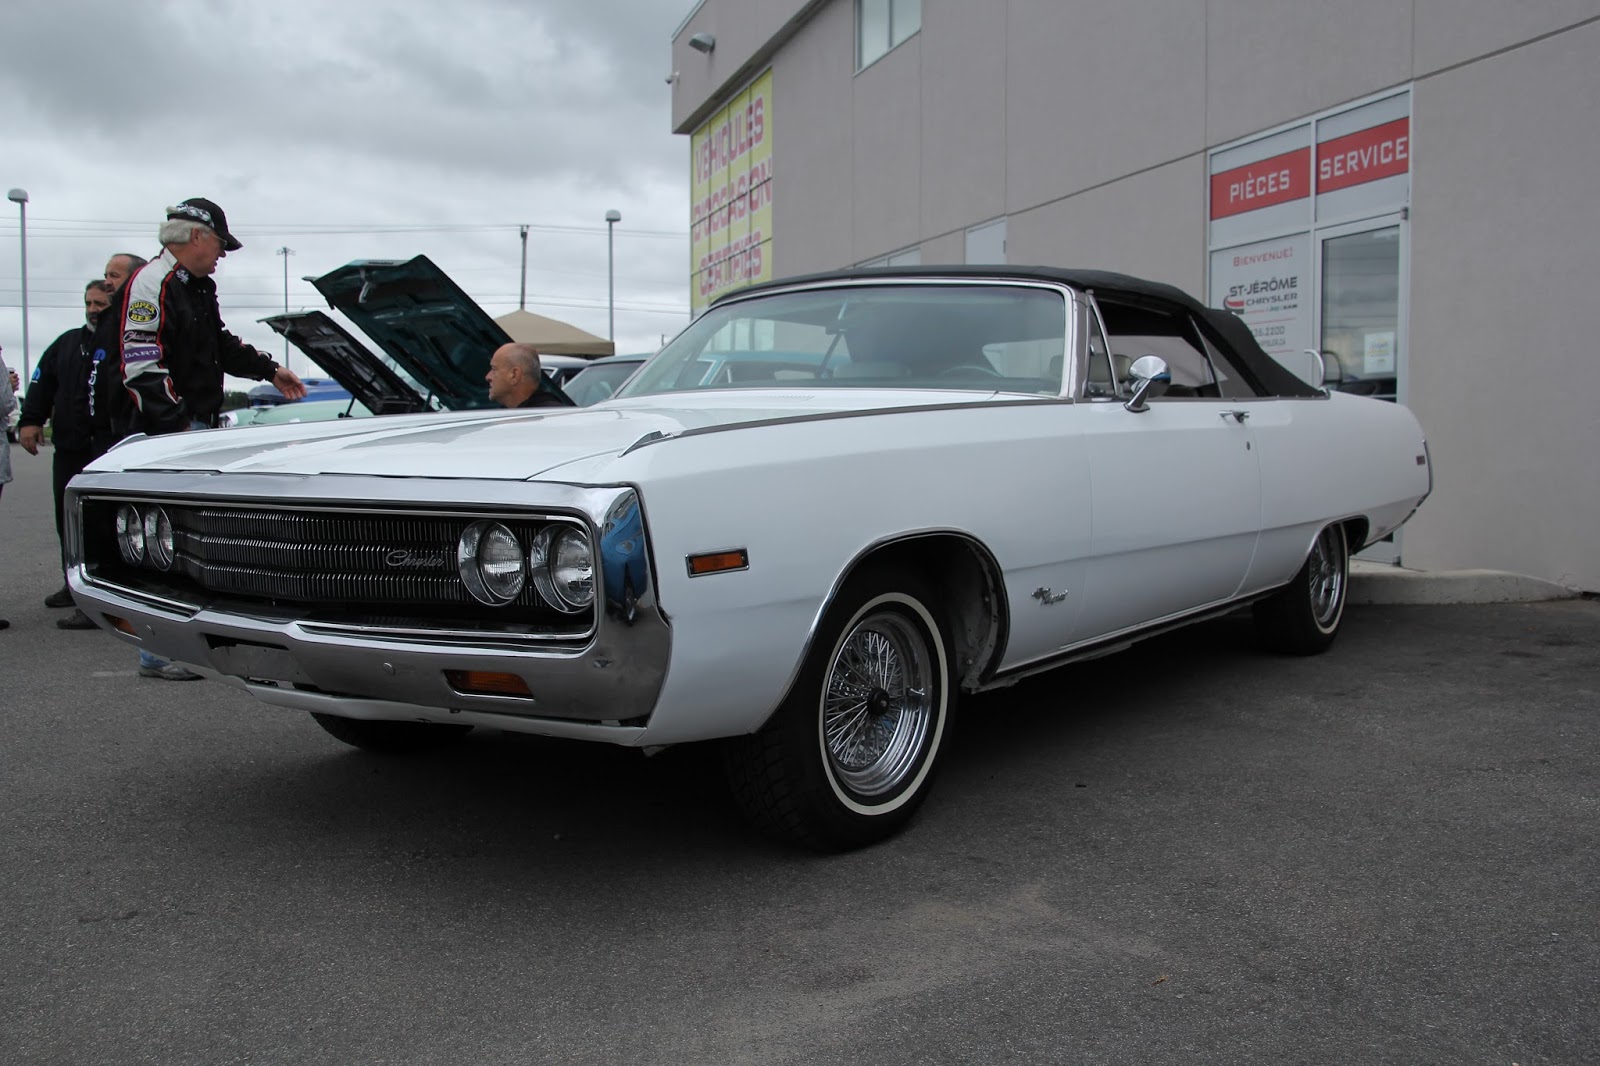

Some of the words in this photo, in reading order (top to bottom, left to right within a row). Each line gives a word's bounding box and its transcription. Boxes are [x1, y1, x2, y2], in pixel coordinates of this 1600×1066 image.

[1320, 136, 1408, 180] SERVICE
[1230, 169, 1290, 203] PIÈCES
[1233, 246, 1293, 267] BIENVENUE!
[1229, 276, 1298, 297] ST-JÉRÔME
[1246, 293, 1298, 306] CHRYSLER
[130, 313, 152, 322] BEE
[124, 350, 159, 359] DART
[385, 549, 445, 570] Chrysler
